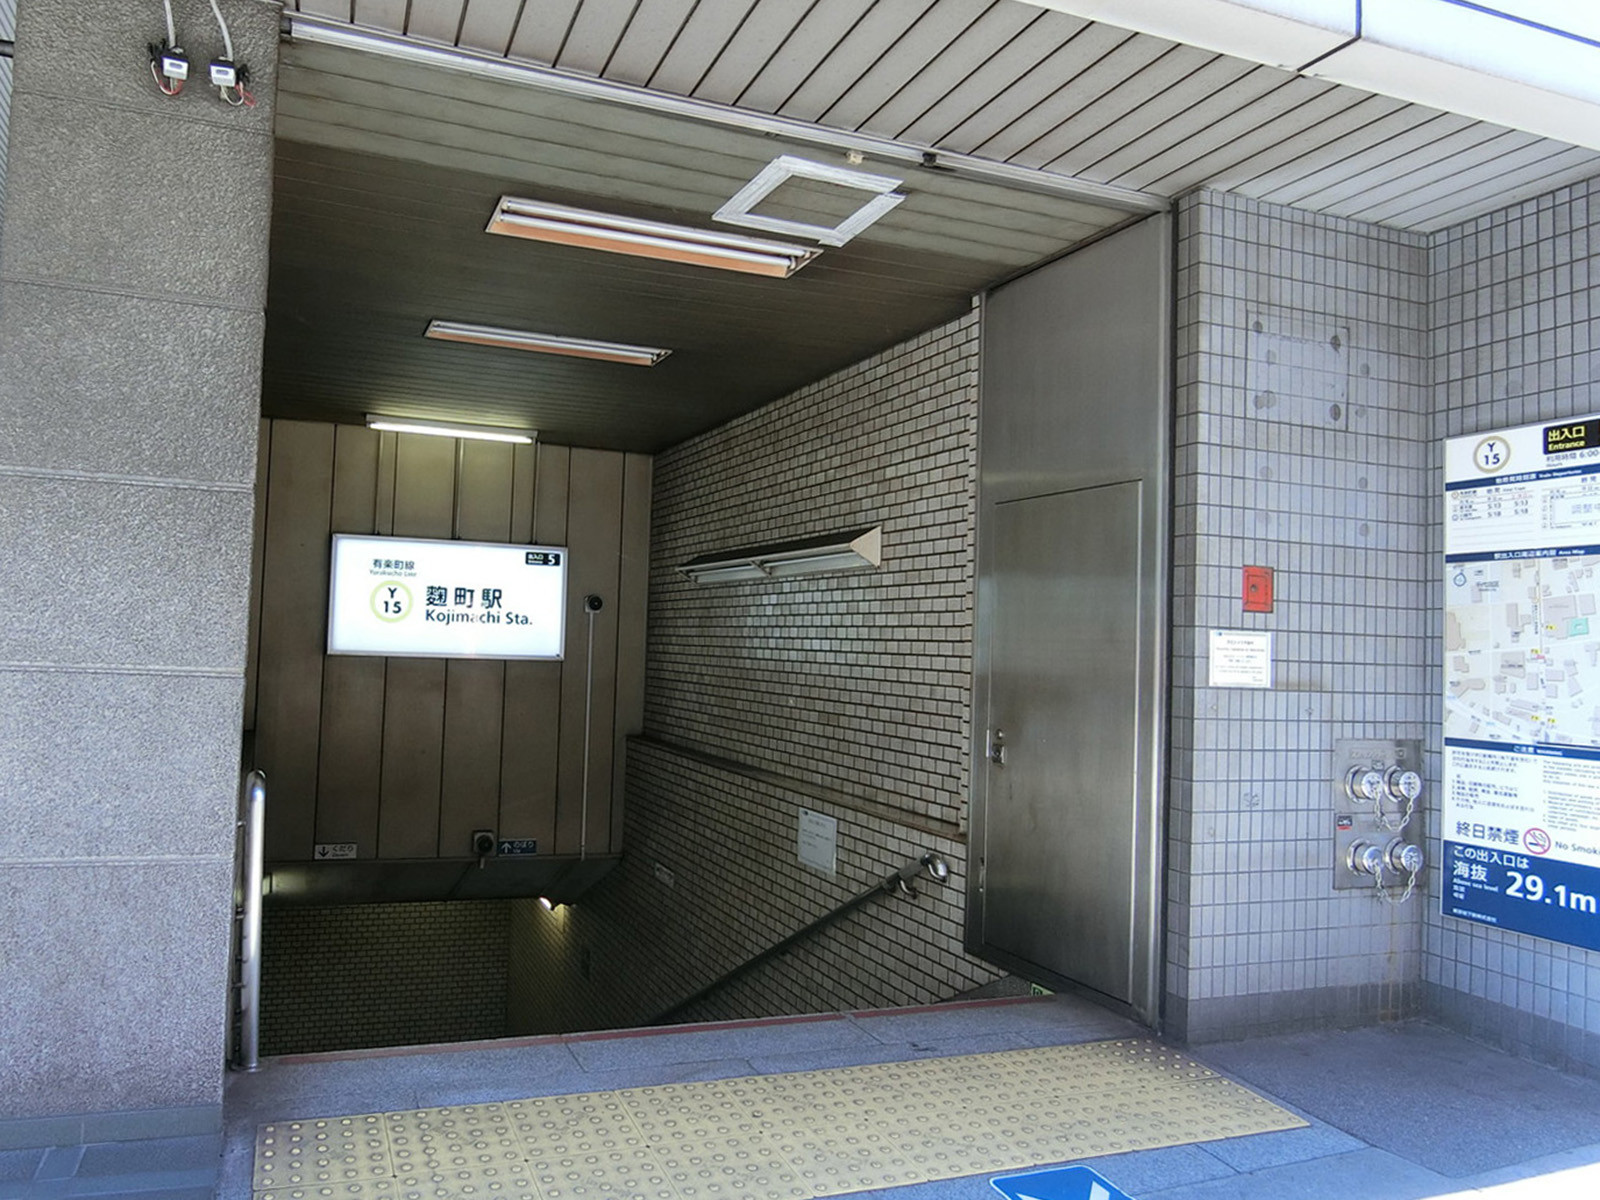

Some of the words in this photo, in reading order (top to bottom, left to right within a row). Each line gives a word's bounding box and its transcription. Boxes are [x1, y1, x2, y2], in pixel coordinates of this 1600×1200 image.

[1548, 426, 1585, 442] 出入口
[1487, 441, 1496, 453] Y
[1548, 440, 1585, 451] Entrance
[1484, 453, 1501, 465] 15
[548, 554, 556, 565] 5
[387, 587, 397, 599] Y
[383, 600, 402, 614] 15
[425, 609, 501, 626] Kojimachi
[505, 611, 533, 625] Sta.
[1456, 821, 1519, 845] 終日禁煙
[332, 844, 354, 853] くだり
[513, 841, 534, 849] のぼり
[1555, 840, 1569, 851] No
[1453, 845, 1530, 870] この出入口は
[1453, 860, 1488, 882] 海抜
[1505, 870, 1597, 914] 29.1m
